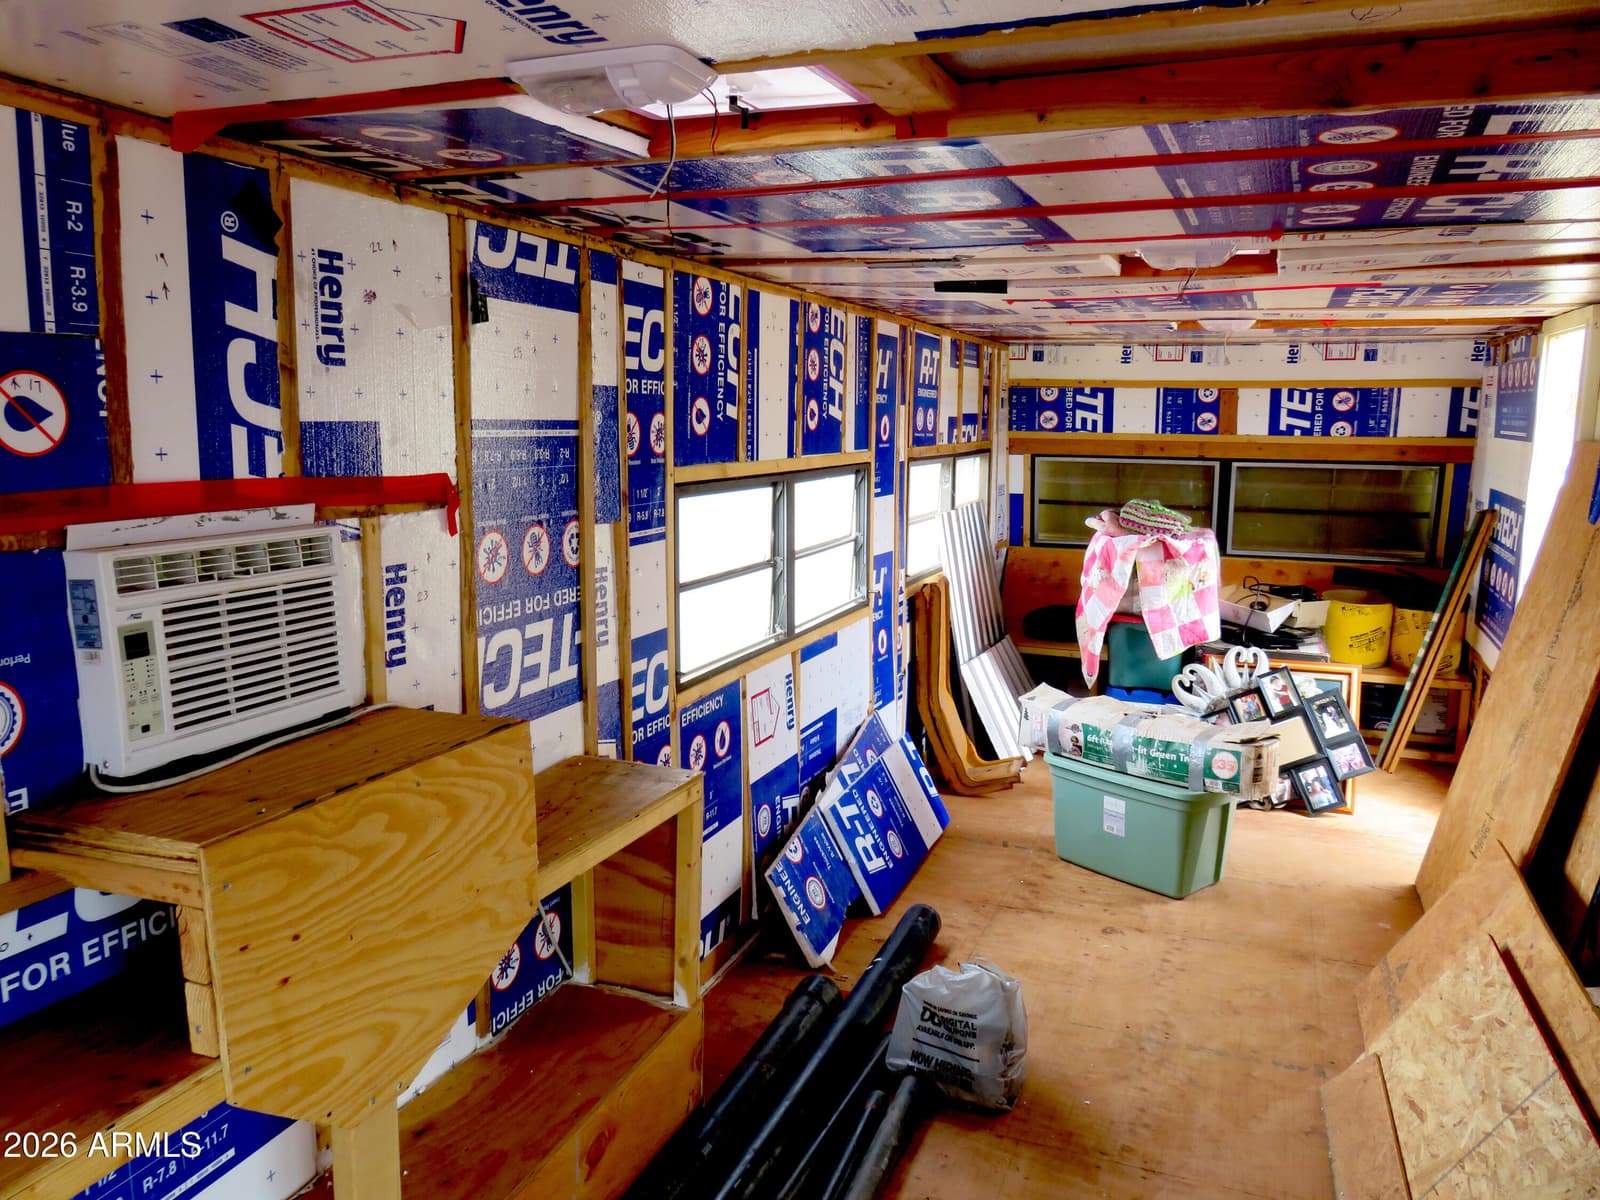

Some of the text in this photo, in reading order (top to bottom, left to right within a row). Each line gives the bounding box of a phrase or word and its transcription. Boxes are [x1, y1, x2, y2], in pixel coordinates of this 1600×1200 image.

[66, 200, 83, 232] R-2
[70, 266, 88, 312] R-3.9
[719, 282, 727, 315] FOR
[317, 248, 347, 367] Henry
[717, 322, 726, 421] EFFICIENCY
[821, 338, 829, 420] EFFICIENCY
[1315, 392, 1325, 411] FOR
[1065, 410, 1073, 428] FOR
[385, 563, 407, 668] Henry
[525, 597, 550, 614] FOR
[681, 694, 724, 728] EFFICIENCY
[785, 673, 796, 731] Henry
[1150, 748, 1176, 760] Green
[852, 788, 894, 870] ENGINEERED
[775, 862, 811, 926] ENGINEE
[1, 951, 72, 1002] FOR
[537, 967, 565, 997] FOR
[940, 1016, 977, 1031] DIGITAL
[910, 1050, 934, 1068] NOW
[142, 1159, 177, 1193] R-7.8
